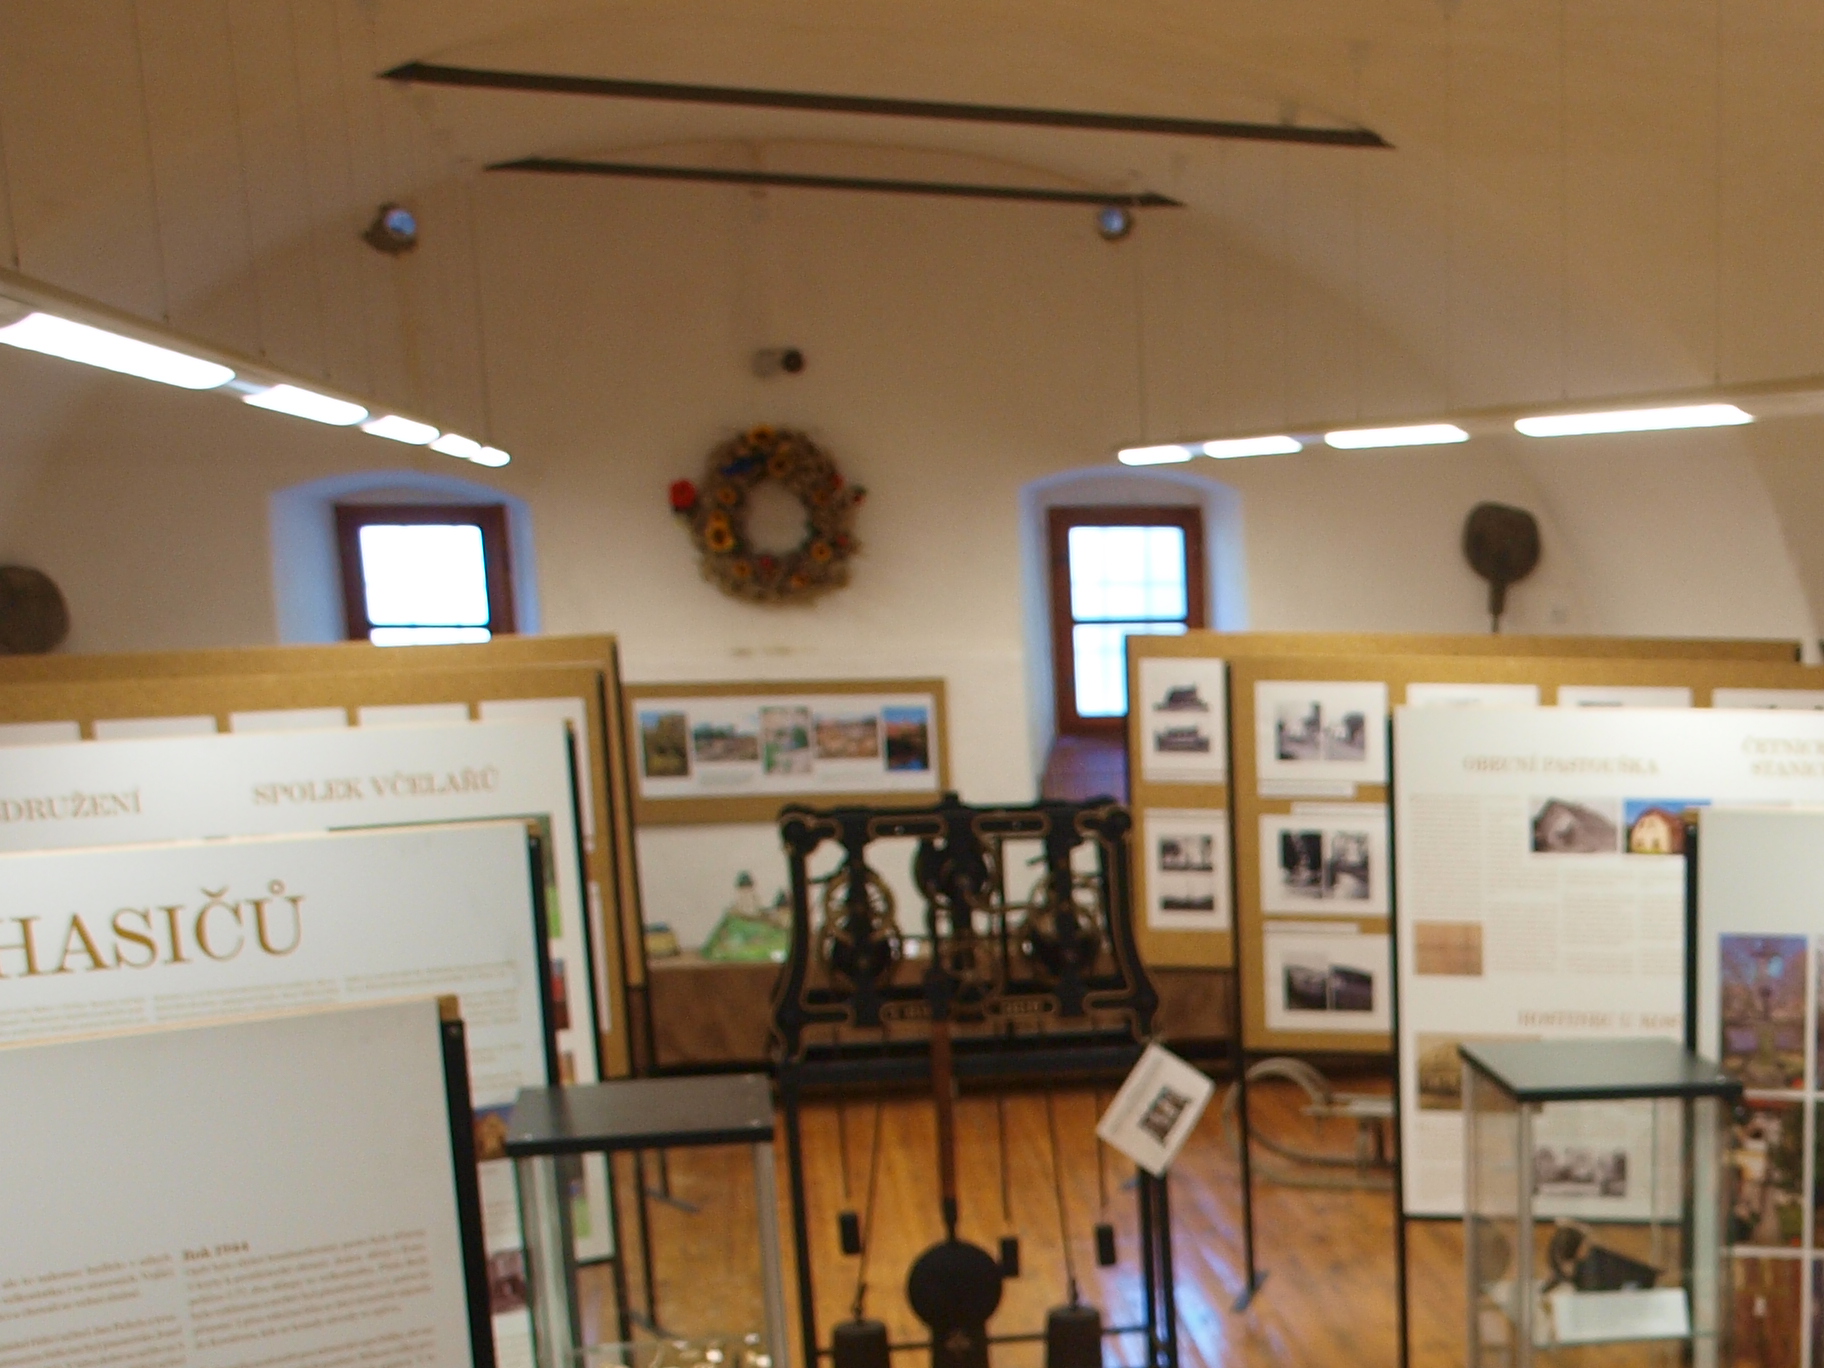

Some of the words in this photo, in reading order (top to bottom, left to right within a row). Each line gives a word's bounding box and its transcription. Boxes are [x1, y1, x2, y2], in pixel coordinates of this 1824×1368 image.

[0, 788, 145, 823] DRUŽENÍ
[253, 775, 364, 804] SPOLEK
[0, 879, 305, 980] HASIČŮ
